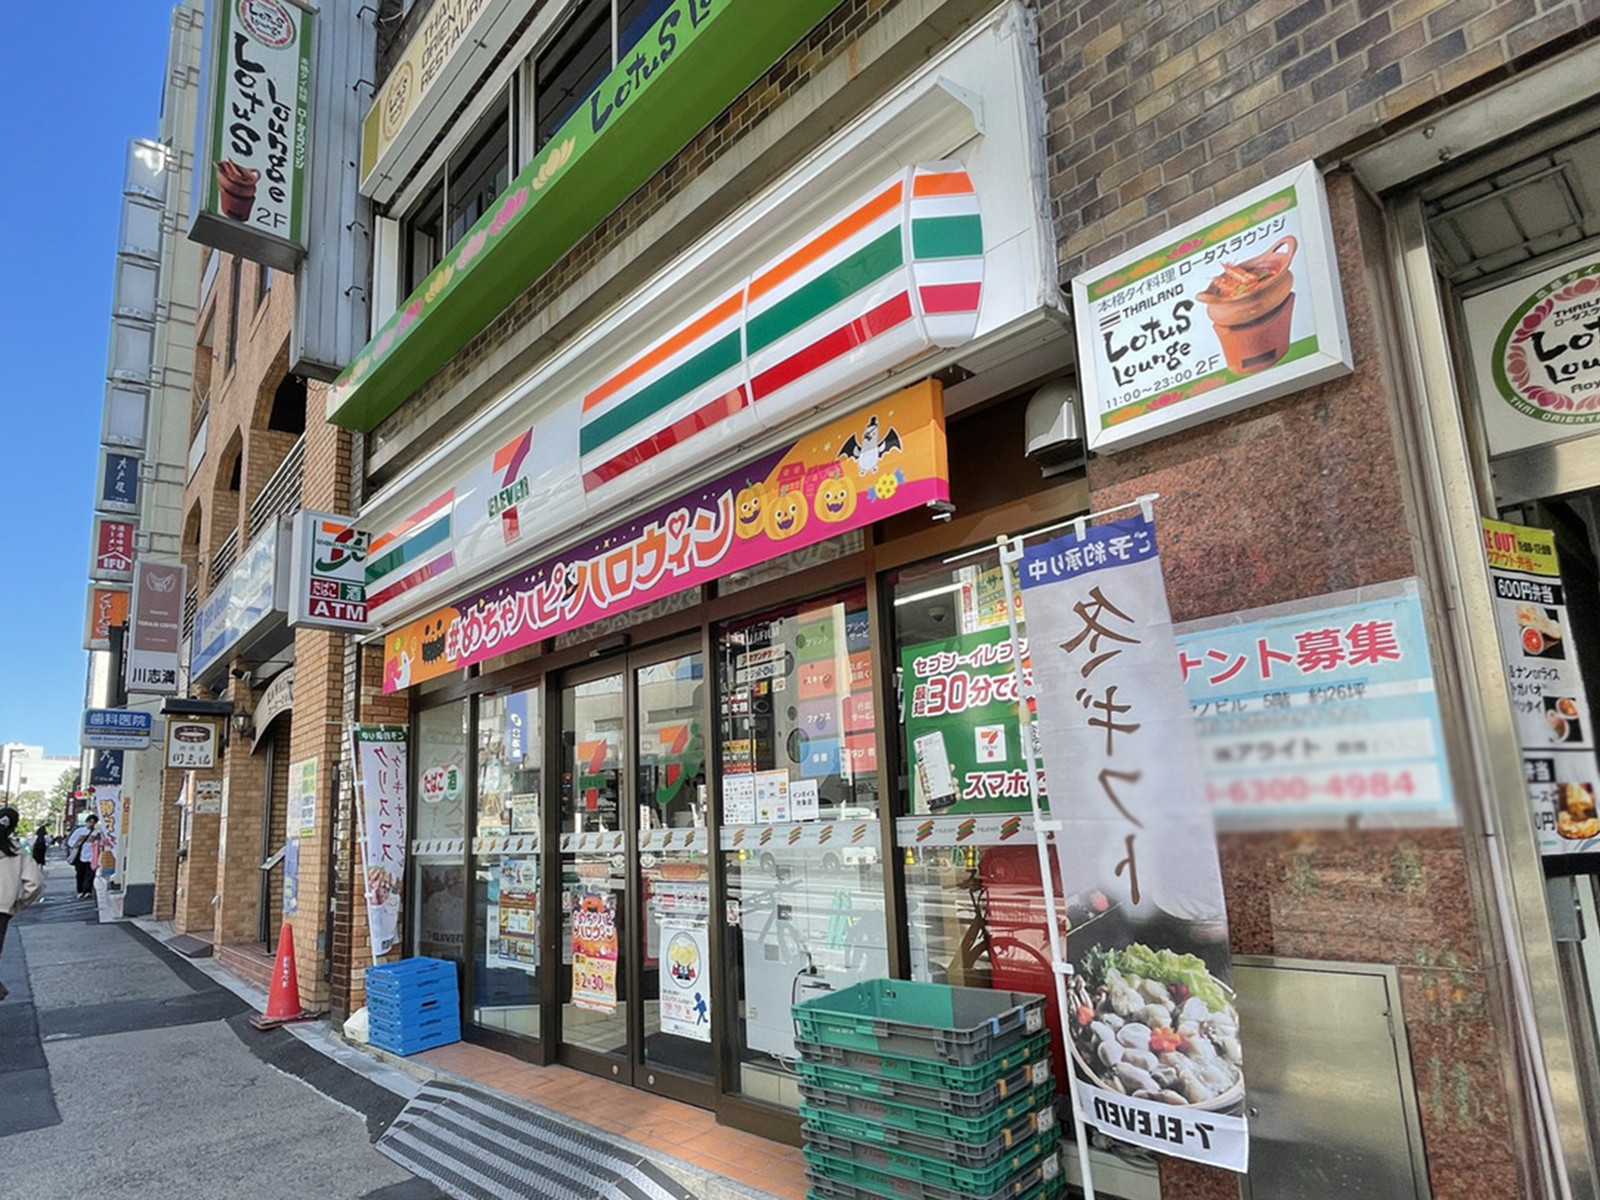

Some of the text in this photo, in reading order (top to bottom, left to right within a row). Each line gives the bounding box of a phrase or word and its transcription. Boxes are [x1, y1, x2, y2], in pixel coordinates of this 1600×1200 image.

[256, 207, 288, 229] 2F
[1097, 217, 1287, 313] 本格タイ料理 ロータスラウンジ
[1122, 282, 1185, 319] THAILAND
[1194, 353, 1222, 377] 2F
[1510, 396, 1536, 415] THAI
[1494, 530, 1517, 553] OUT
[103, 558, 126, 569] IFU
[312, 580, 361, 601] たばこ 酒
[1498, 579, 1554, 604] 600円弁当
[314, 600, 364, 621] ATM
[132, 668, 176, 684] 川志満
[1191, 698, 1248, 717] ノビル
[90, 712, 147, 727] 歯科医院
[424, 772, 444, 793] たばこ
